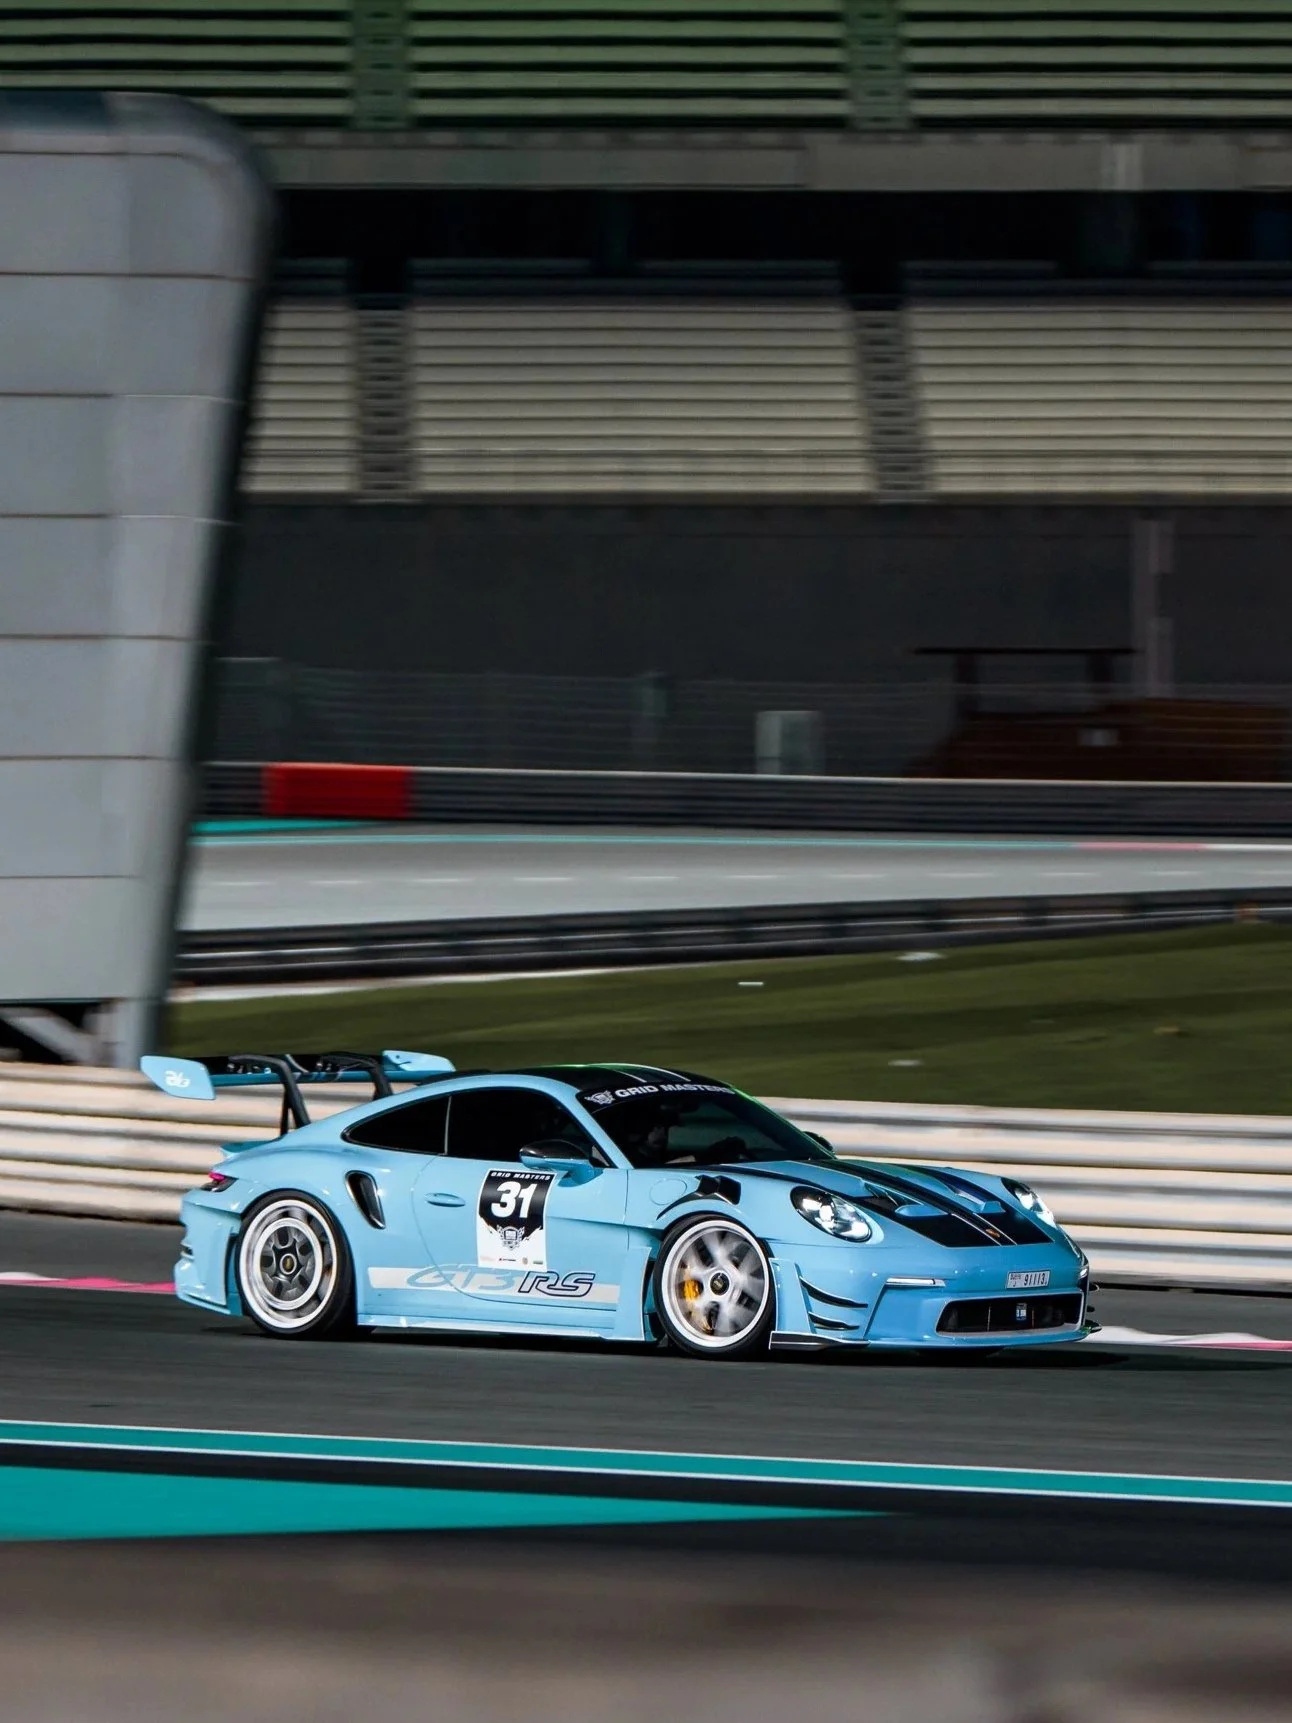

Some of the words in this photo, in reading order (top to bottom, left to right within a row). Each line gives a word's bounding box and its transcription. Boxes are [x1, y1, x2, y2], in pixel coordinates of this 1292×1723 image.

[614, 1084, 660, 1099] GRID
[661, 1083, 736, 1095] MASTERS
[513, 1173, 551, 1181] MASTERS
[491, 1181, 538, 1219] 31
[406, 1263, 518, 1291] GT3
[517, 1270, 596, 1298] RS
[1023, 1272, 1047, 1287] 91113
